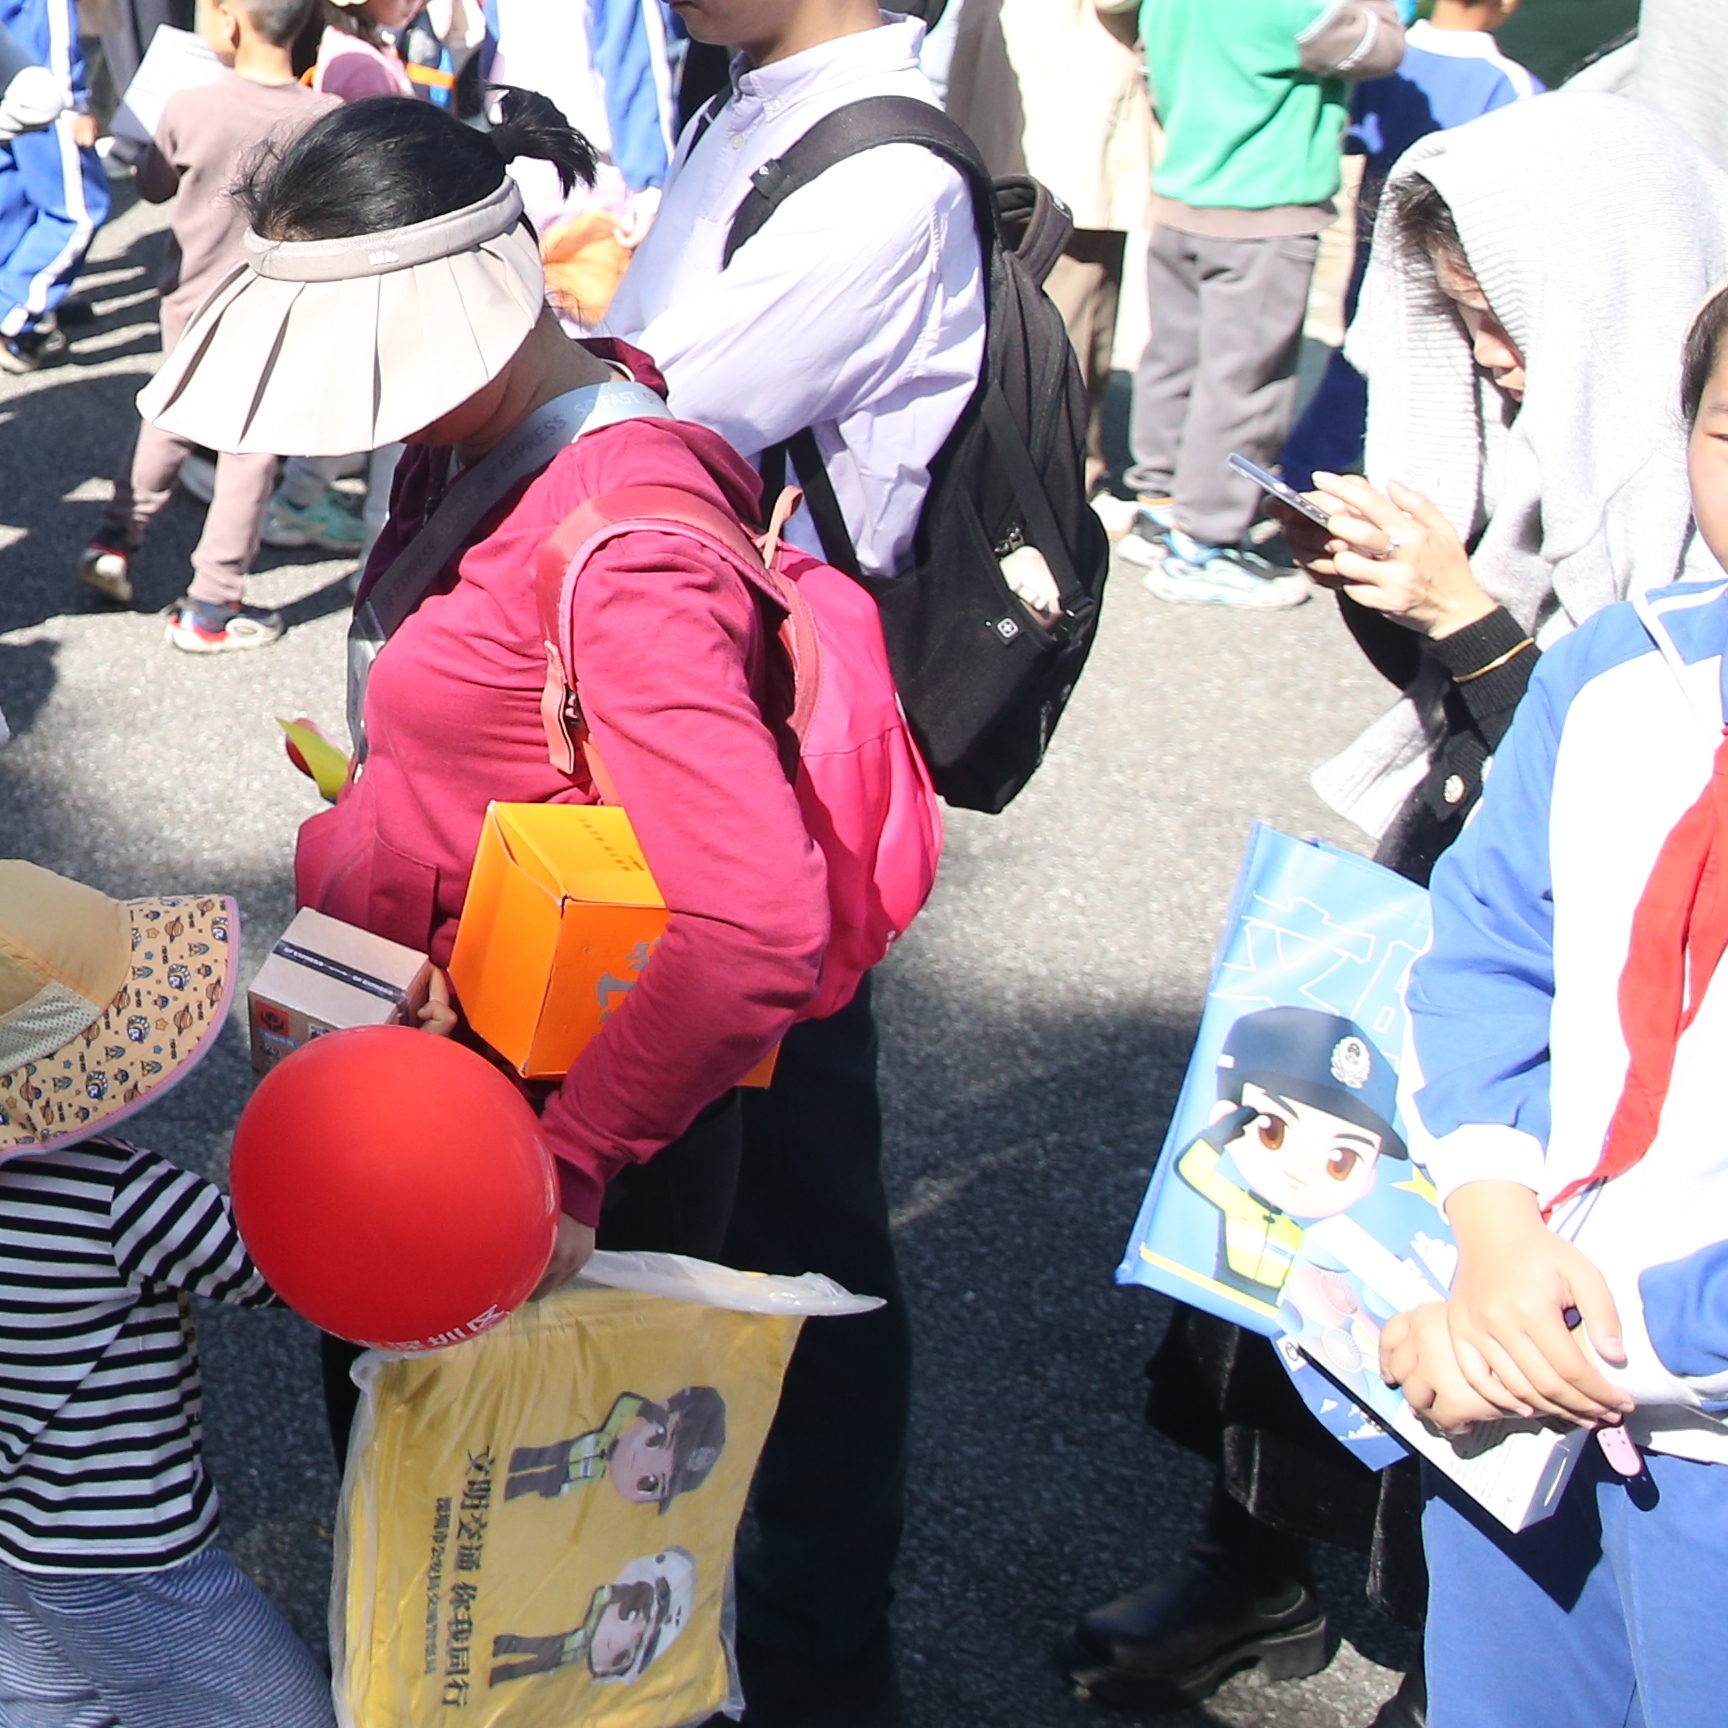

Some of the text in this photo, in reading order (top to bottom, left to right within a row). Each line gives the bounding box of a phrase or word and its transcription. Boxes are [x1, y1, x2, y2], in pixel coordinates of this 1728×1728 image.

[500, 414, 567, 472] EXPRESS
[602, 391, 641, 408] FAST
[442, 1445, 496, 1709] 文明交通 你我同行
